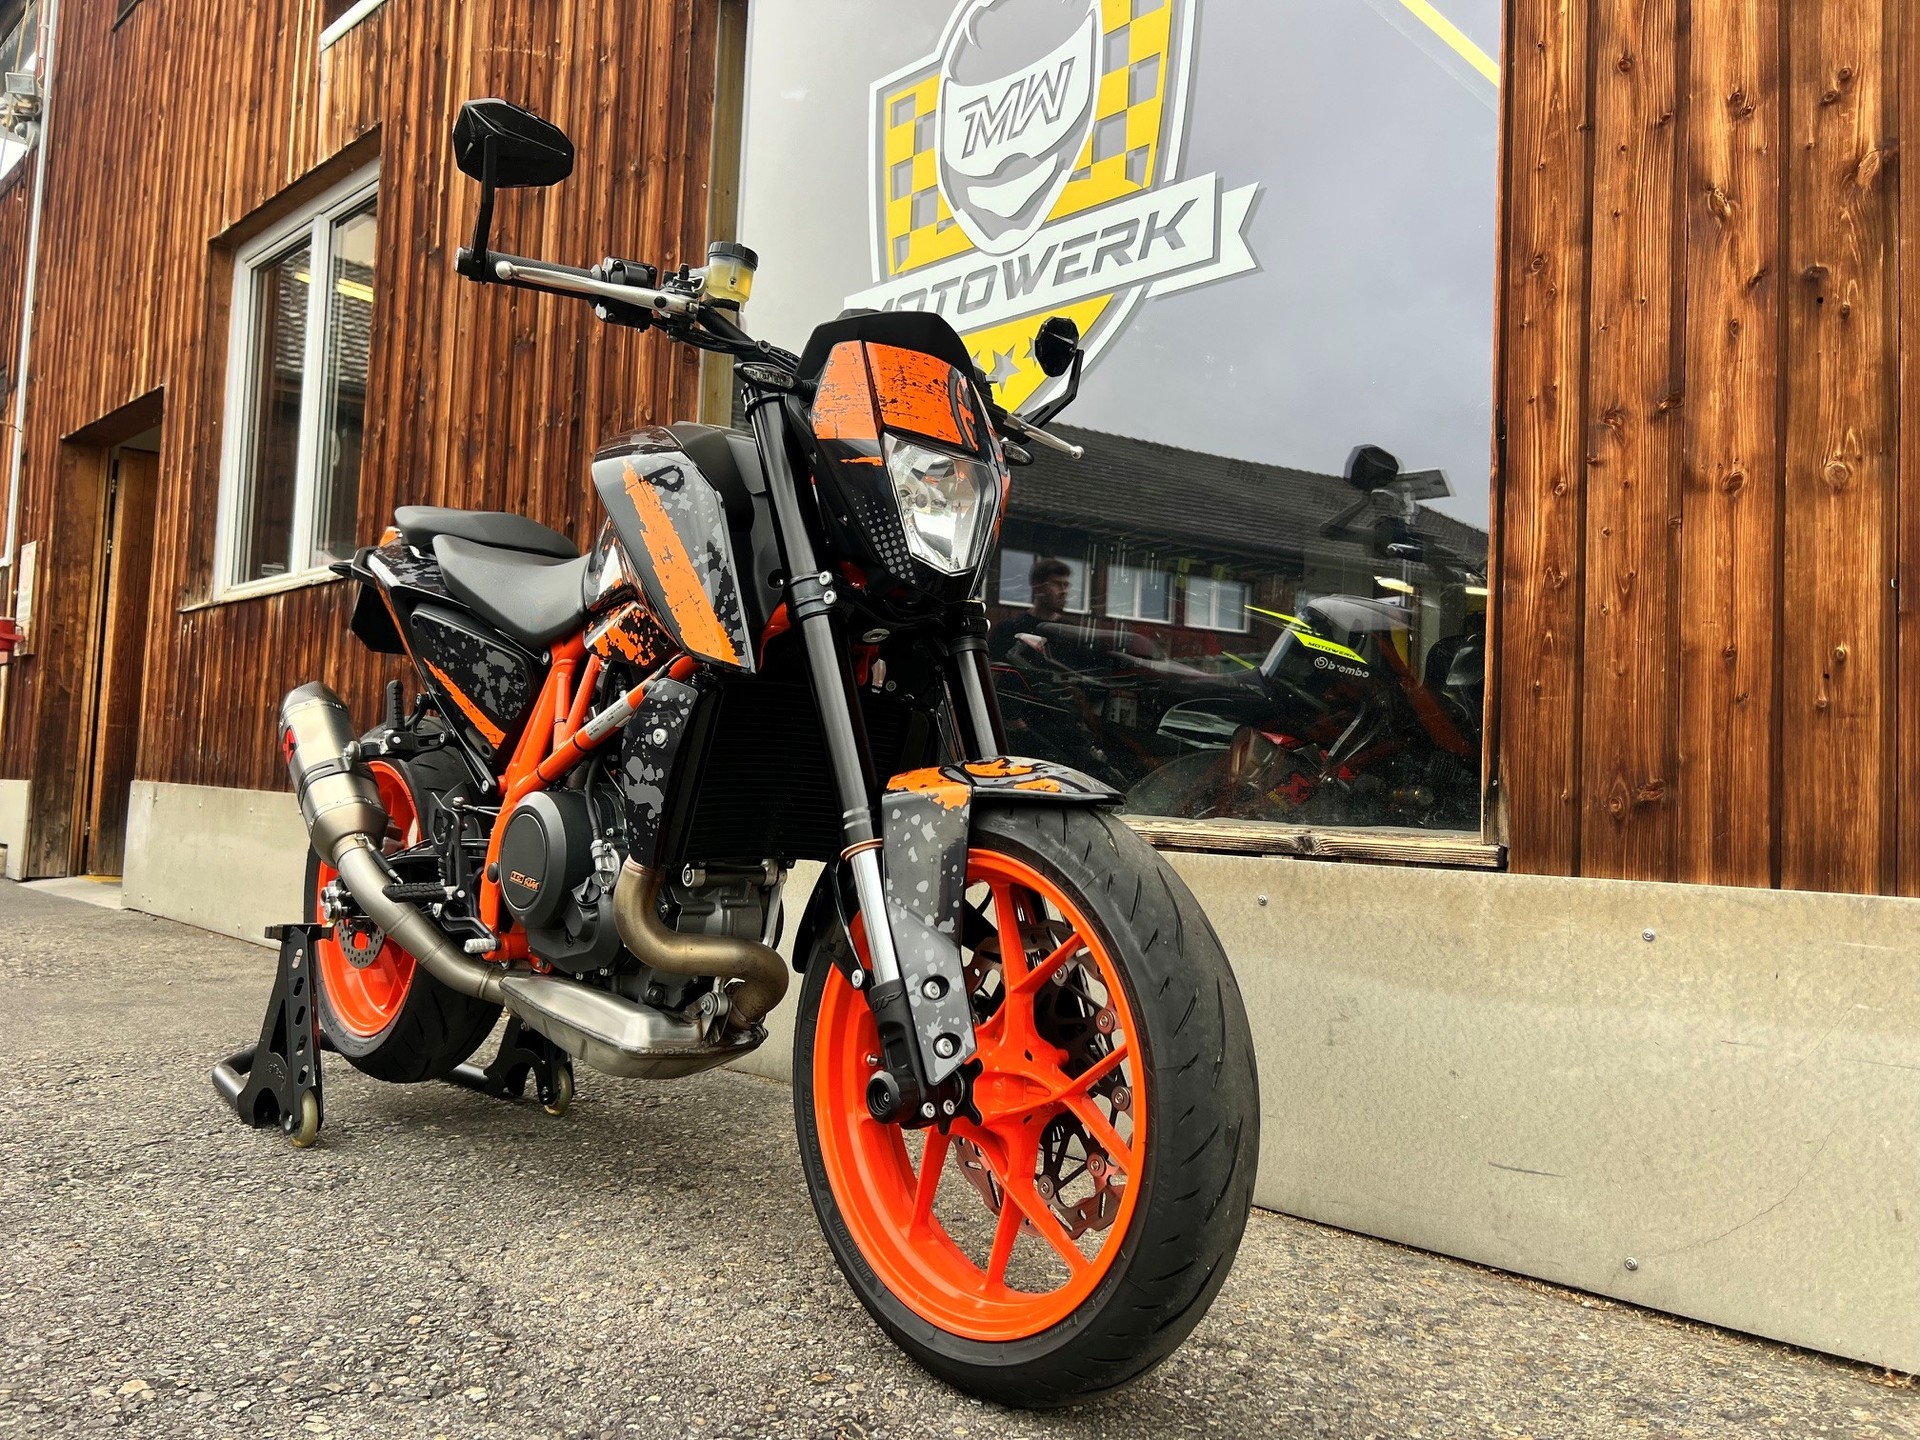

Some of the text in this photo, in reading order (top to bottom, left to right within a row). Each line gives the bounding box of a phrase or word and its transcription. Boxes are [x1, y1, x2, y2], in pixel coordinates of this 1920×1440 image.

[959, 56, 1076, 159] MW
[880, 197, 1200, 315] OTOWERK
[1307, 641, 1356, 659] MOTOWERK
[832, 1217, 874, 1282] BRIDGESTONE
